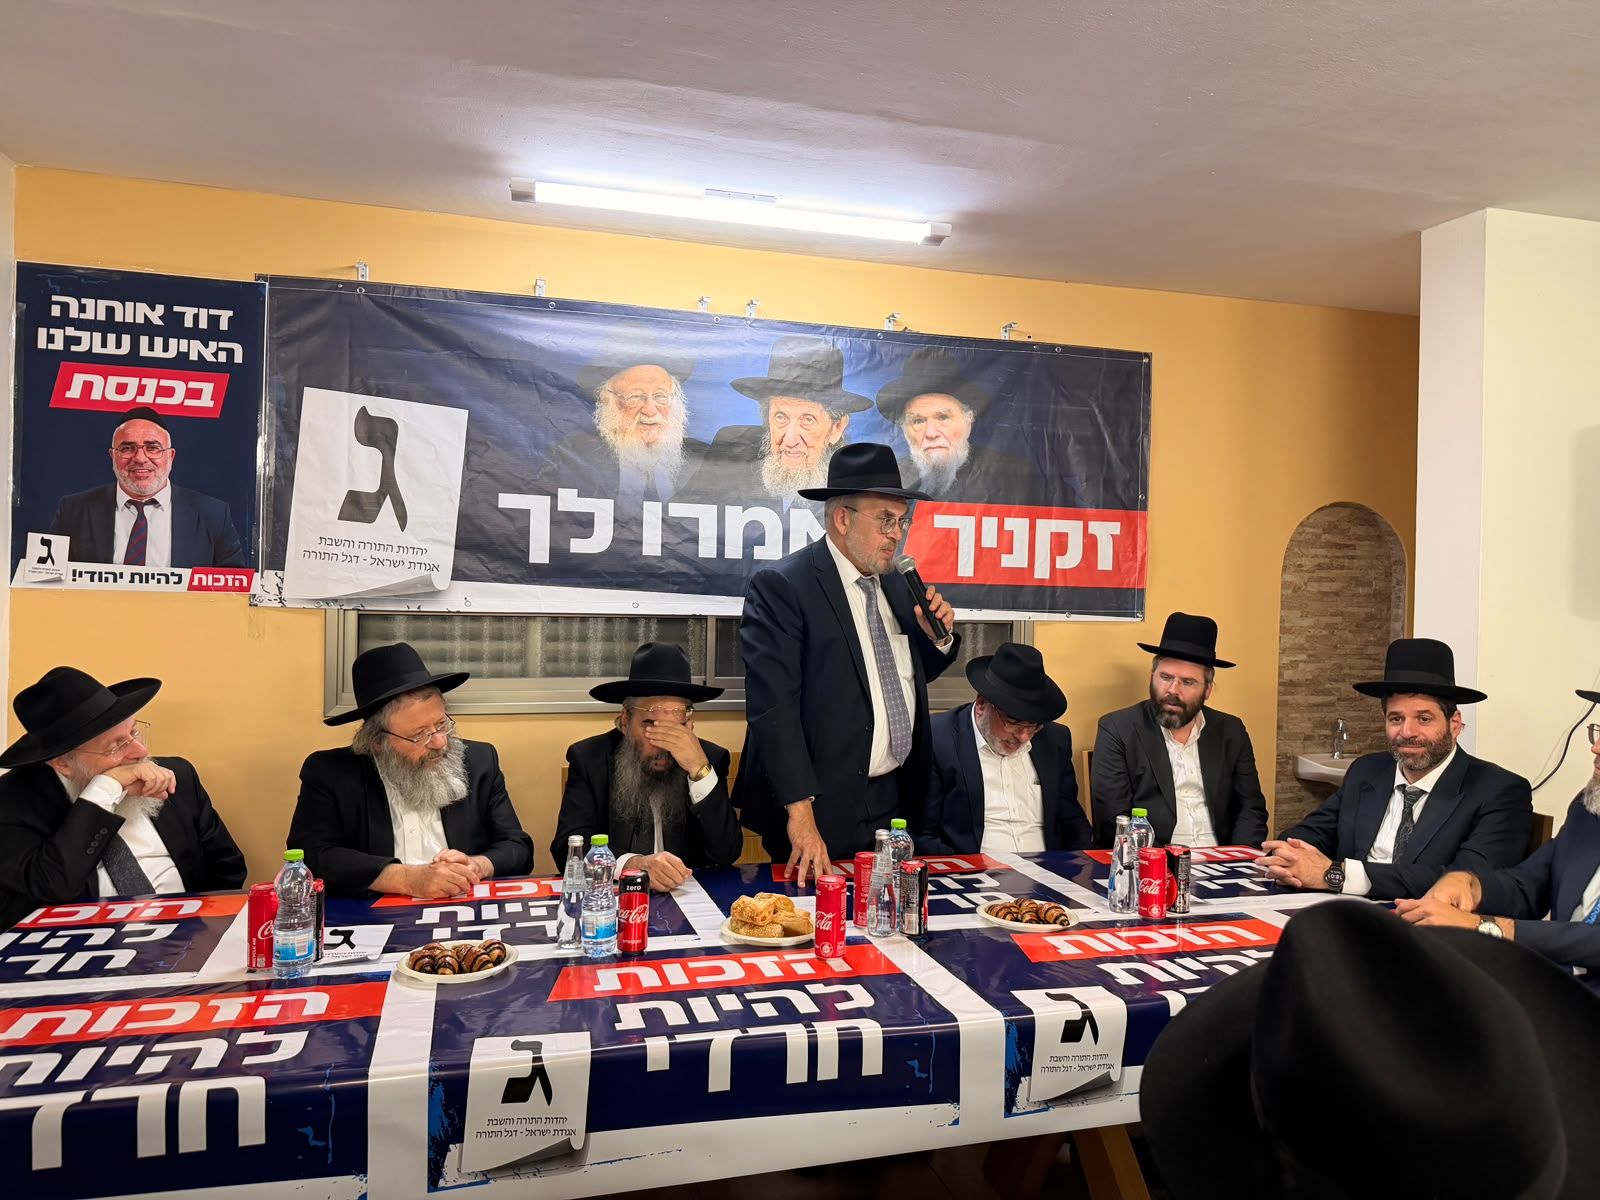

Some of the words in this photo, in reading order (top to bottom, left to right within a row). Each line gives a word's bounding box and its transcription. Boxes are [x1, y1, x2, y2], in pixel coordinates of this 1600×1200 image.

[51, 295, 164, 327] אוחנה
[173, 305, 234, 331] דוד
[37, 327, 131, 356] שלנו
[140, 335, 243, 364] האיש
[65, 372, 215, 407] בכנסת
[337, 405, 408, 533] ג
[497, 488, 615, 564] לך
[318, 536, 355, 549] והשבת
[358, 540, 394, 553] התורה
[933, 514, 1122, 579] זקניך
[37, 536, 55, 566] ג
[303, 549, 339, 561] התורה
[341, 552, 360, 564] דגל
[396, 545, 428, 556] יהדות
[370, 555, 405, 568] ישראל
[407, 560, 440, 572] אגודת
[71, 569, 124, 583] יהודי!
[129, 570, 183, 585] להיות
[191, 572, 248, 587] הזכות
[18, 899, 203, 924] הזכו
[0, 923, 180, 950] להיו
[1042, 925, 1265, 955] הזכות
[0, 949, 137, 975] חר
[615, 983, 875, 1031] להיות
[0, 992, 330, 1040] הזכות
[1044, 991, 1100, 1046] ג
[644, 1018, 883, 1093] חרדי
[1071, 1054, 1091, 1062] התורה
[1091, 1053, 1109, 1061] יהדות
[500, 1039, 553, 1107] ג
[1062, 1065, 1072, 1073] דגל
[1077, 1064, 1096, 1072] ישראל
[0, 1076, 266, 1171] חרד
[486, 1117, 514, 1126] והשבת
[516, 1116, 543, 1126] התורה
[543, 1116, 568, 1125] יהדות
[475, 1129, 503, 1139] התורה
[504, 1128, 518, 1138] דגל
[525, 1127, 551, 1137] ישראל
[552, 1128, 577, 1137] אגודת
